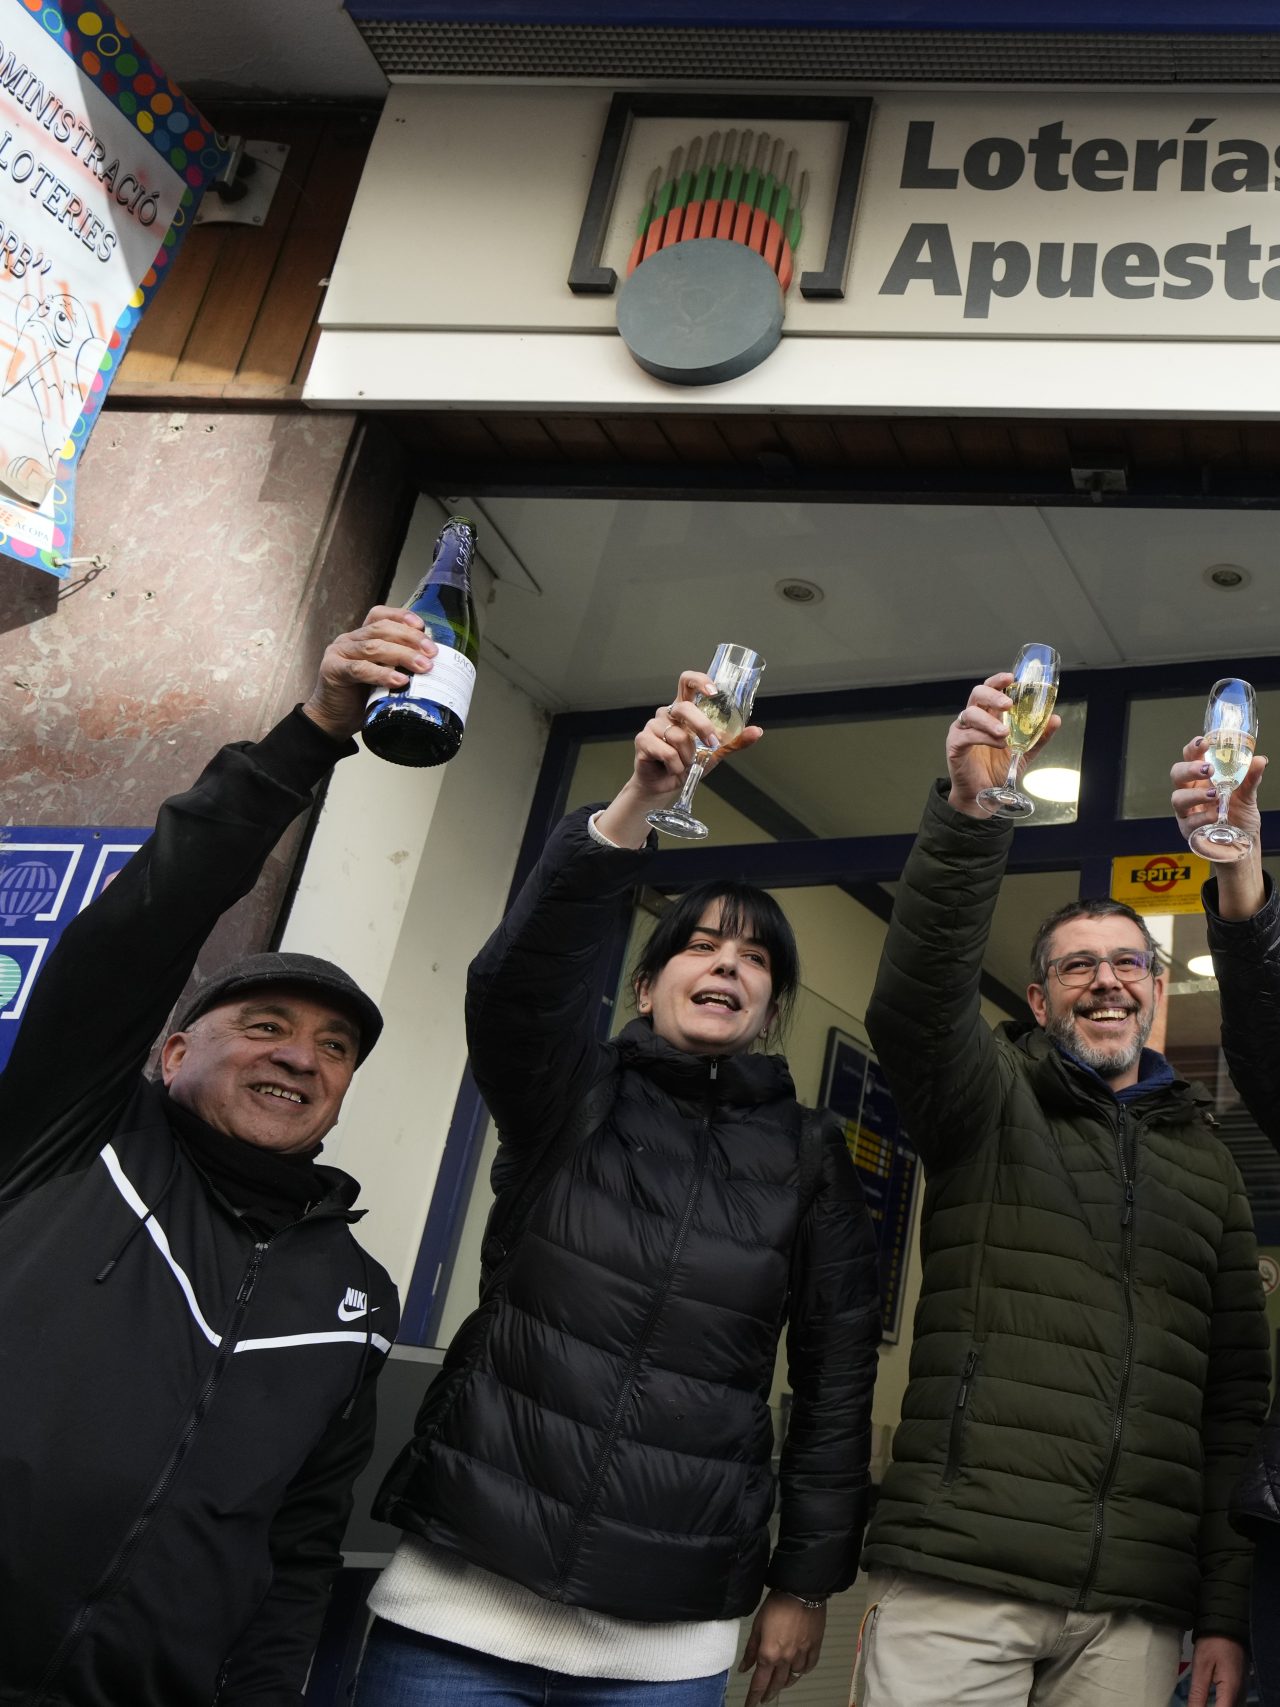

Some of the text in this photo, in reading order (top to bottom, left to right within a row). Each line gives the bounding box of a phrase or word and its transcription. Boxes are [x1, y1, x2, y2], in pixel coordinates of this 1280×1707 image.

[0, 40, 161, 228] MINISTRACIÓ
[0, 131, 117, 263] LOTERIES
[1136, 867, 1187, 882] SPITZ
